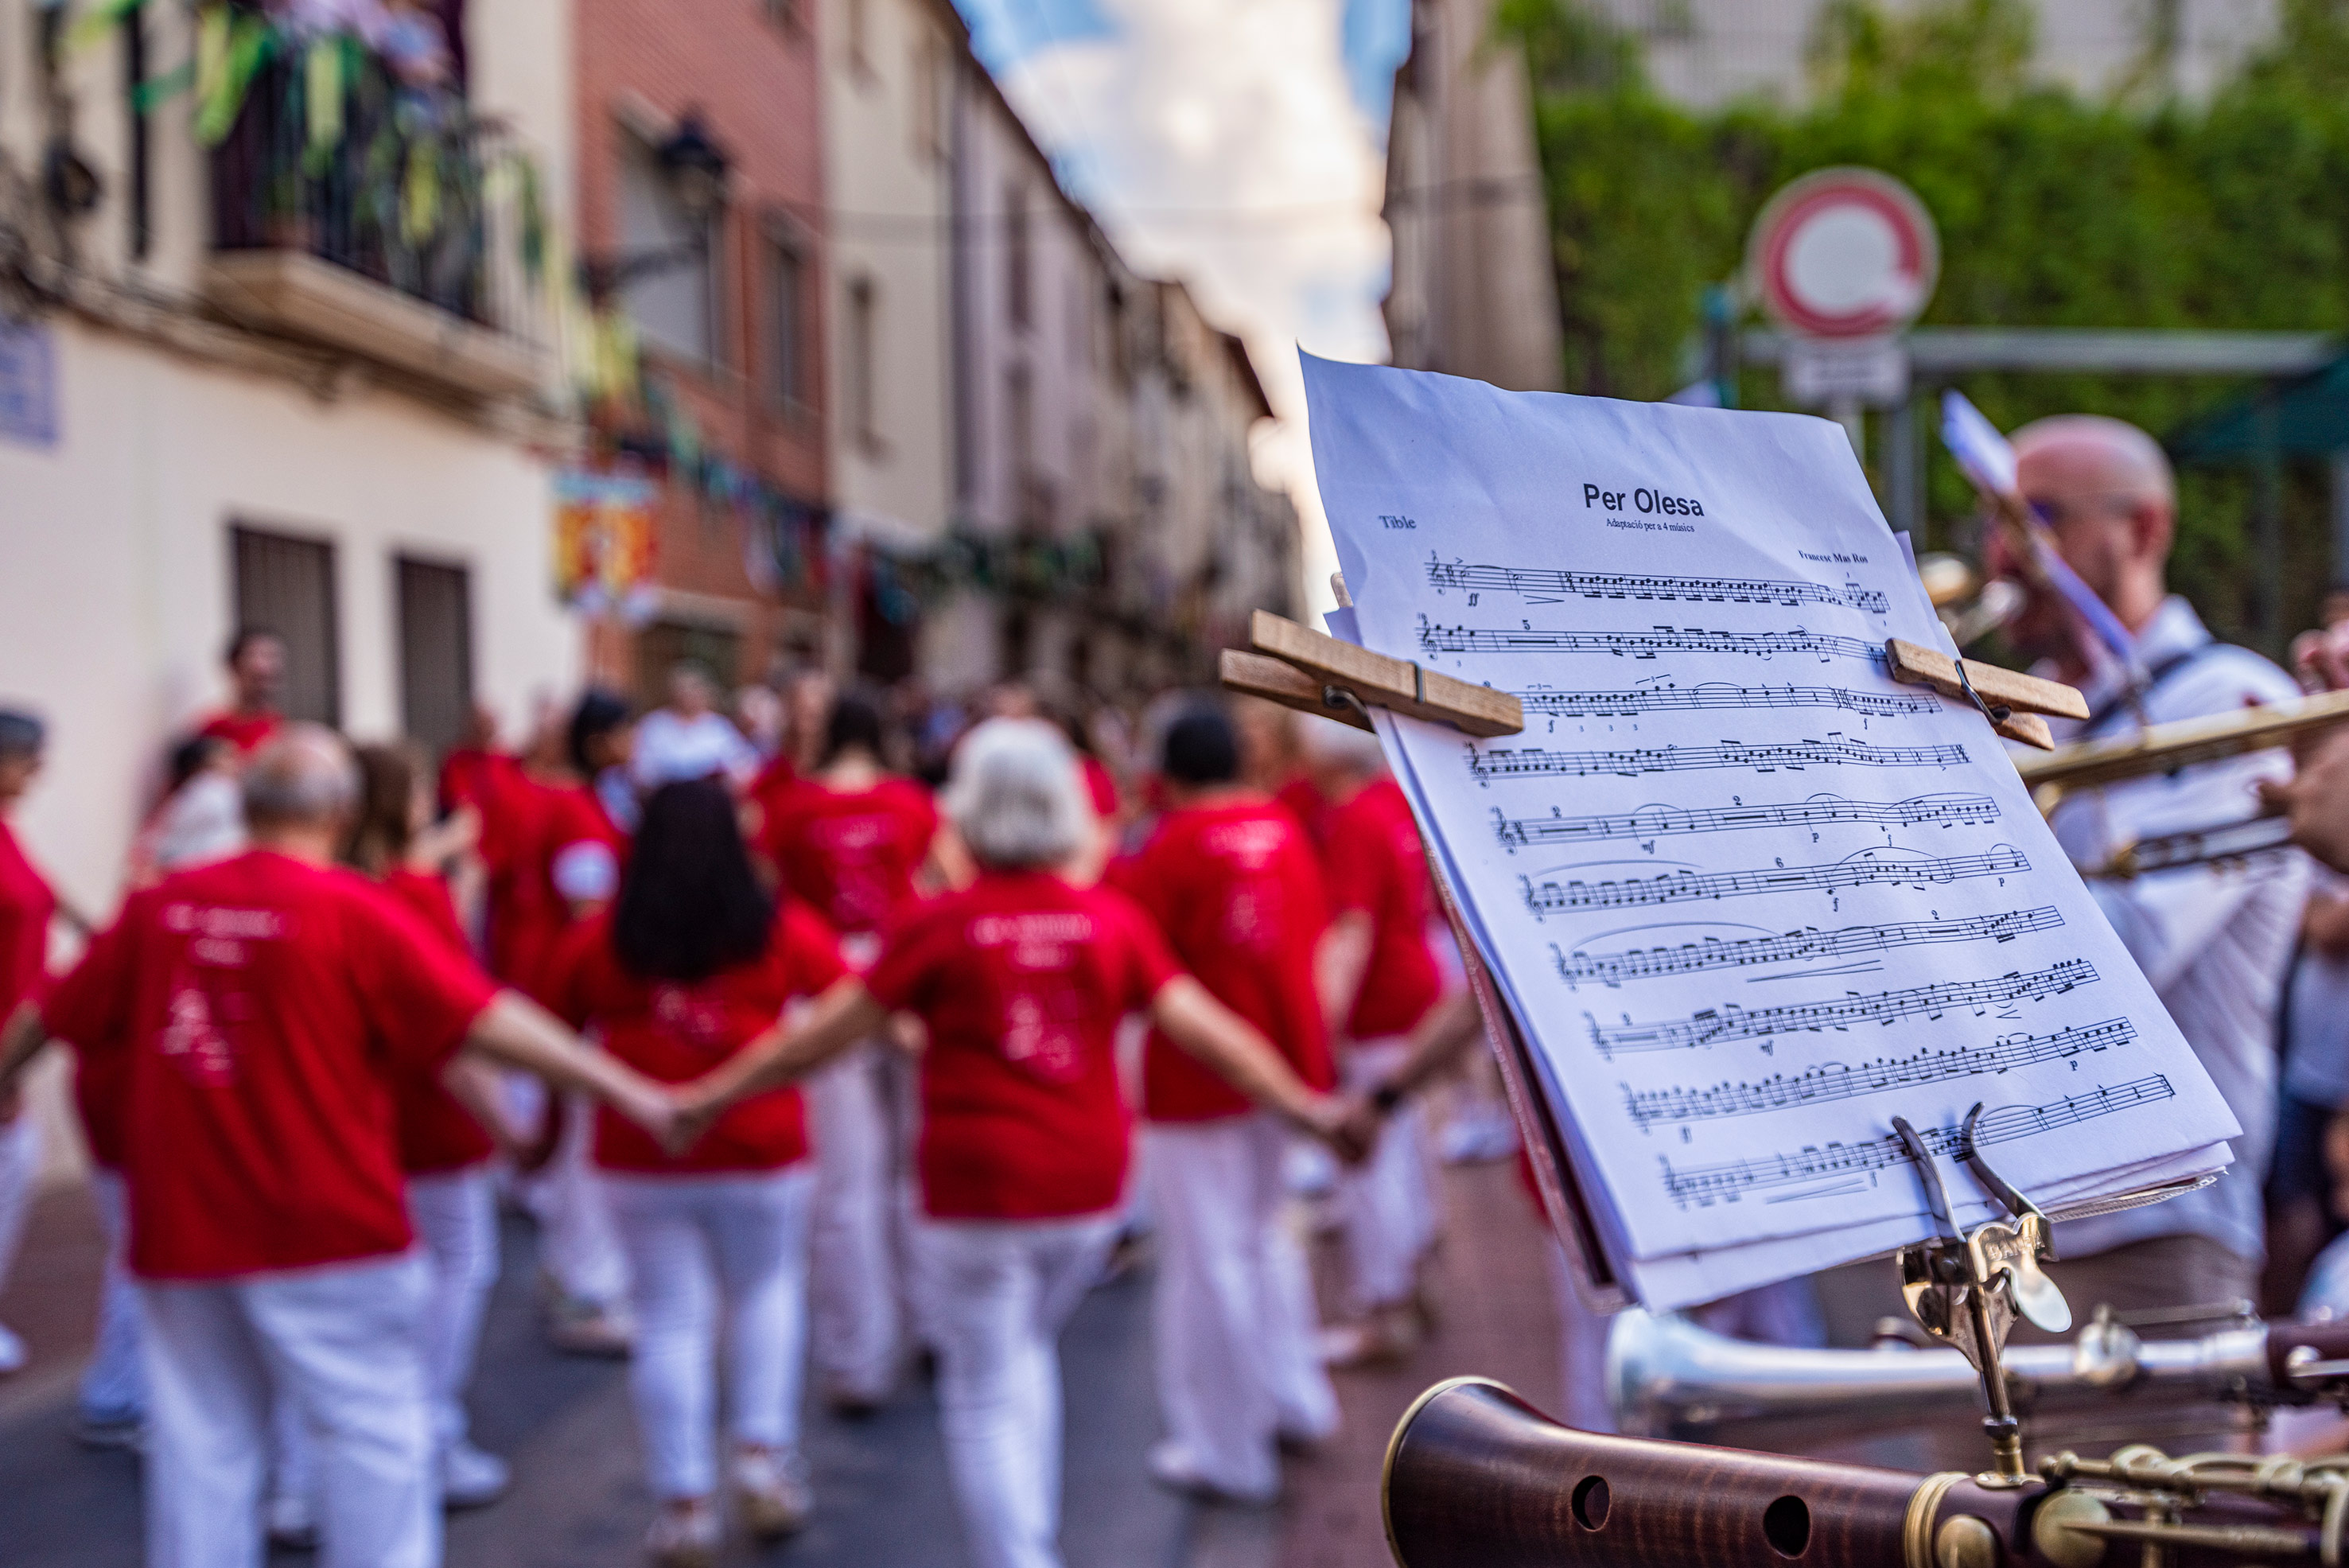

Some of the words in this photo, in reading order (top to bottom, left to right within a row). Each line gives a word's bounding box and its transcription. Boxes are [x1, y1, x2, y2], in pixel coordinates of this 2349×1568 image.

[1583, 483, 1626, 511] Per
[1634, 488, 1705, 517] Olesa
[1379, 515, 1417, 529] Tible
[1607, 518, 1643, 531] Adaptació
[1643, 522, 1655, 532] per
[1663, 522, 1669, 531] 4
[1670, 522, 1696, 532] músics
[1798, 549, 1832, 563] Francesc
[1833, 553, 1852, 563] Mas
[1852, 553, 1869, 563] Ros
